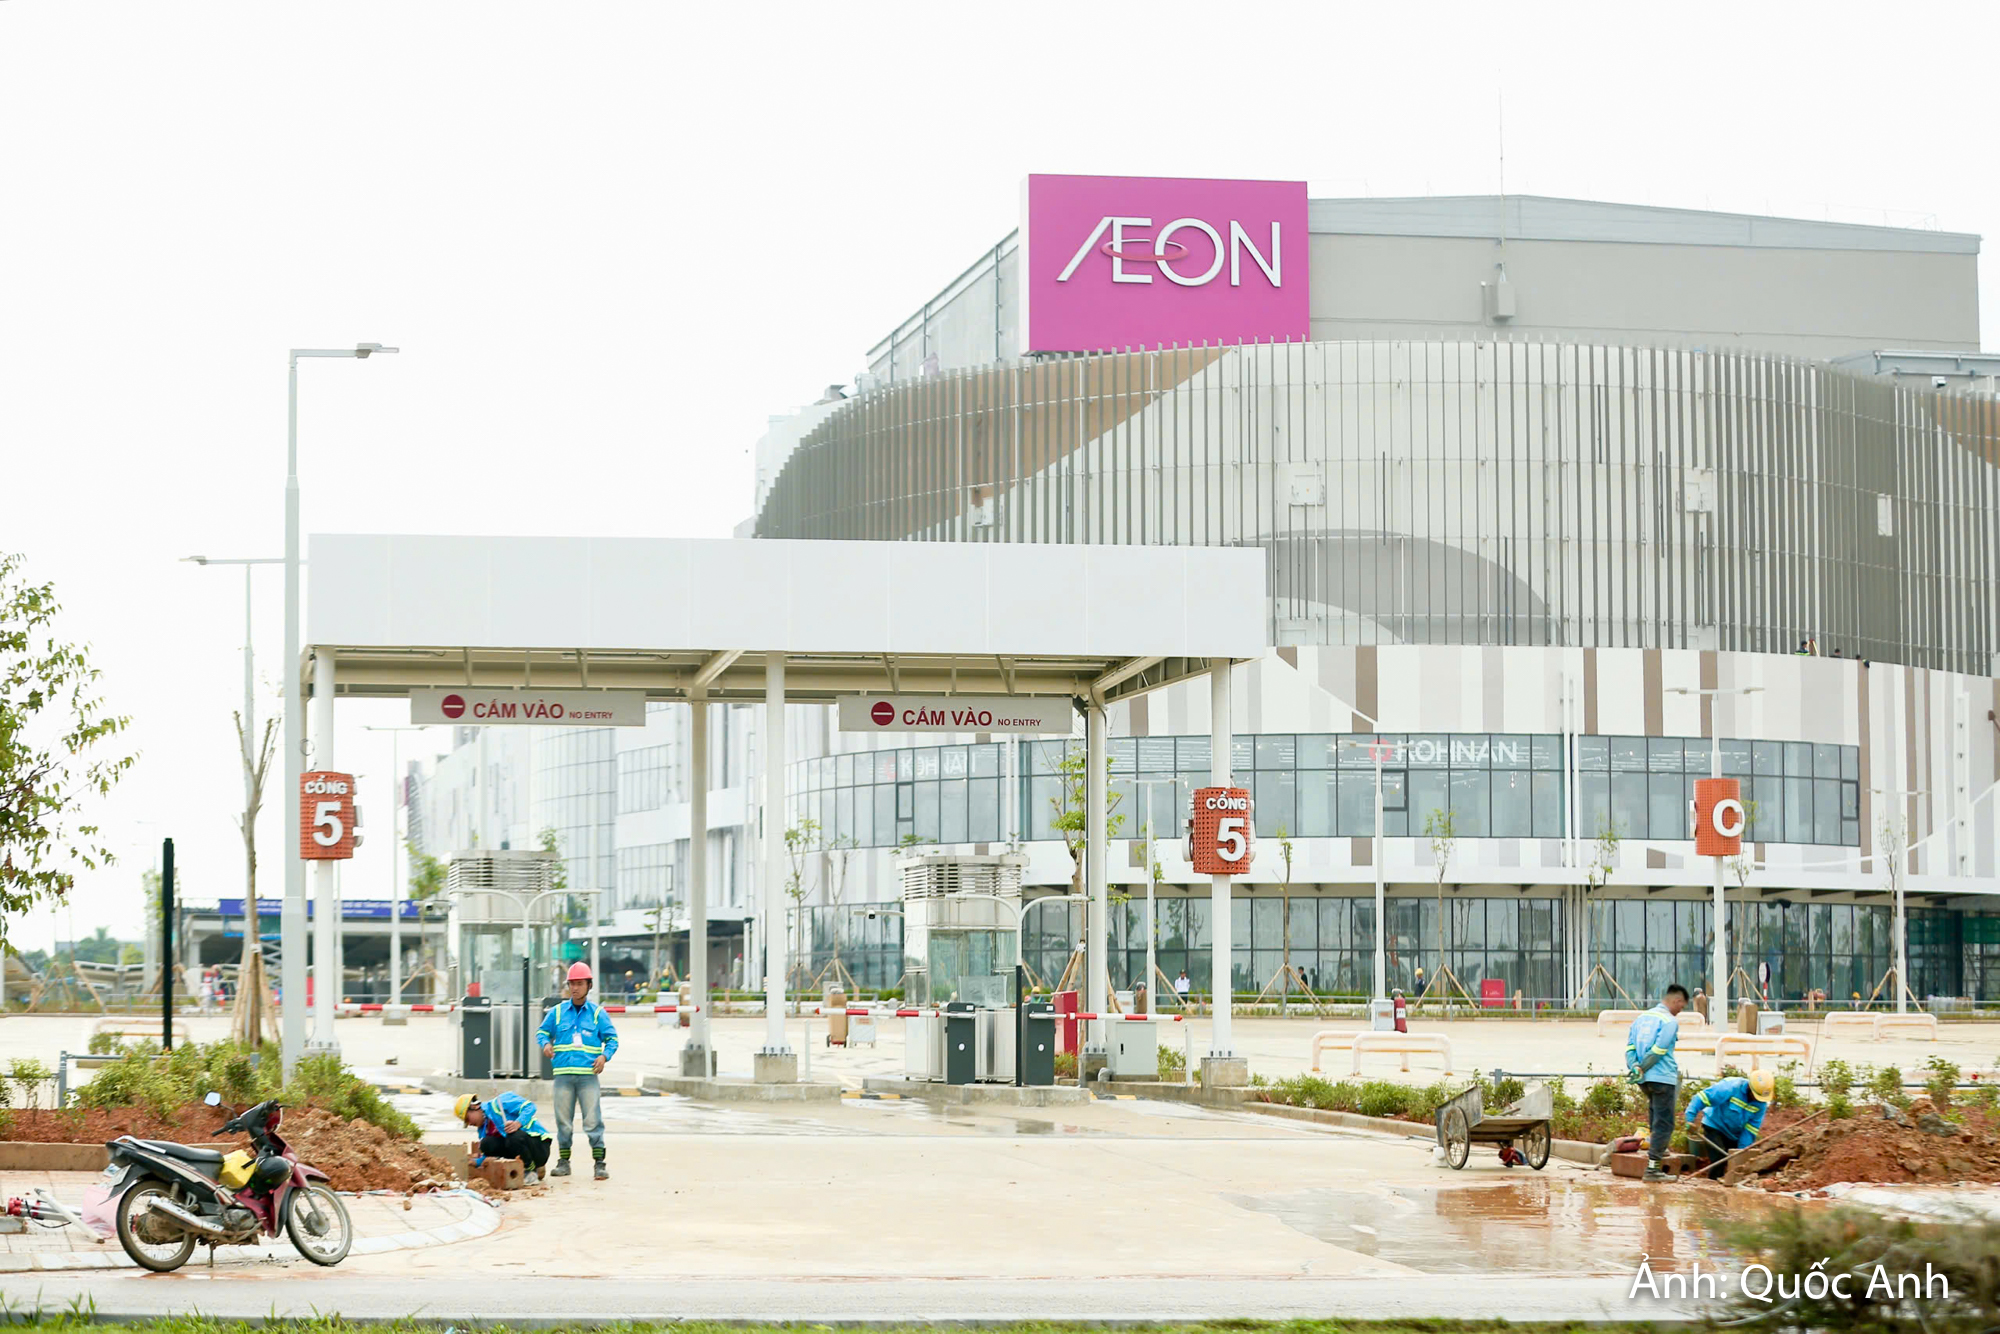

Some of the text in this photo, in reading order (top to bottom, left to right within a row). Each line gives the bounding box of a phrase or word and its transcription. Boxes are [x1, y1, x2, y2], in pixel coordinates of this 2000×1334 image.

[522, 699, 564, 719] VÀO
[569, 711, 582, 719] NO
[584, 711, 613, 719] ENTRY
[902, 706, 1042, 726] CẤM VÀO NO ENTRY
[1396, 739, 1517, 763] KOHNAN
[1206, 790, 1247, 810] CỔNG
[312, 801, 343, 846] 5
[1712, 798, 1746, 838] C
[1216, 817, 1247, 862] 5
